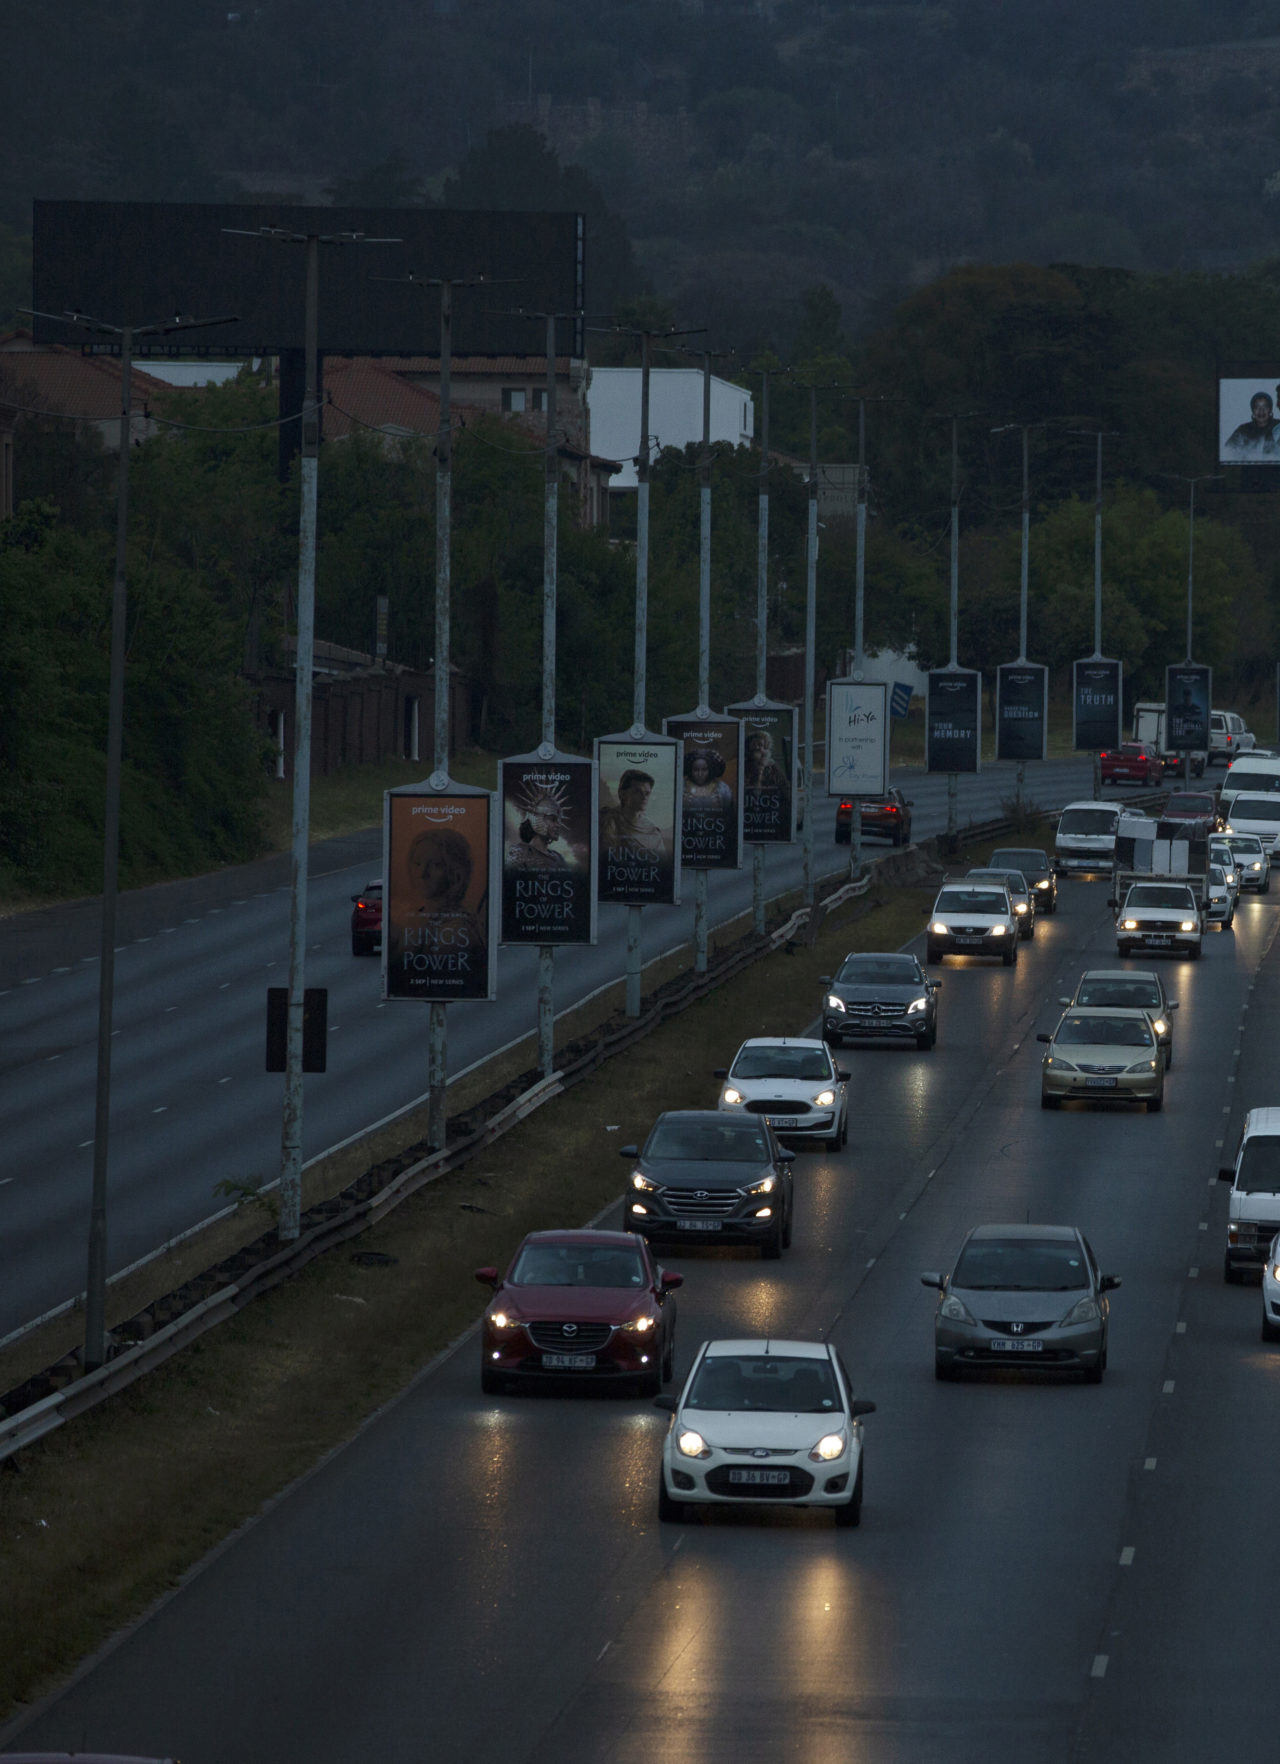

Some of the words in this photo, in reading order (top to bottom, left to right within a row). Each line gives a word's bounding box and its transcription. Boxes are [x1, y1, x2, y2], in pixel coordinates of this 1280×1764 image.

[1080, 694, 1114, 705] TRUTH
[848, 711, 877, 727] Hi-Ya
[683, 731, 703, 739] prime
[704, 730, 723, 739] video
[934, 729, 971, 739] MEMORY
[616, 751, 637, 759] prime
[523, 773, 546, 782] prime
[548, 772, 570, 781] video
[411, 804, 438, 816] prime
[440, 804, 466, 815] video
[744, 811, 781, 824] OWER
[608, 847, 660, 863] RINGS
[607, 866, 661, 882] POWER
[515, 880, 574, 898] RINGS
[515, 901, 576, 919] POWER
[404, 928, 470, 948] RINGS
[402, 952, 472, 972] POWER
